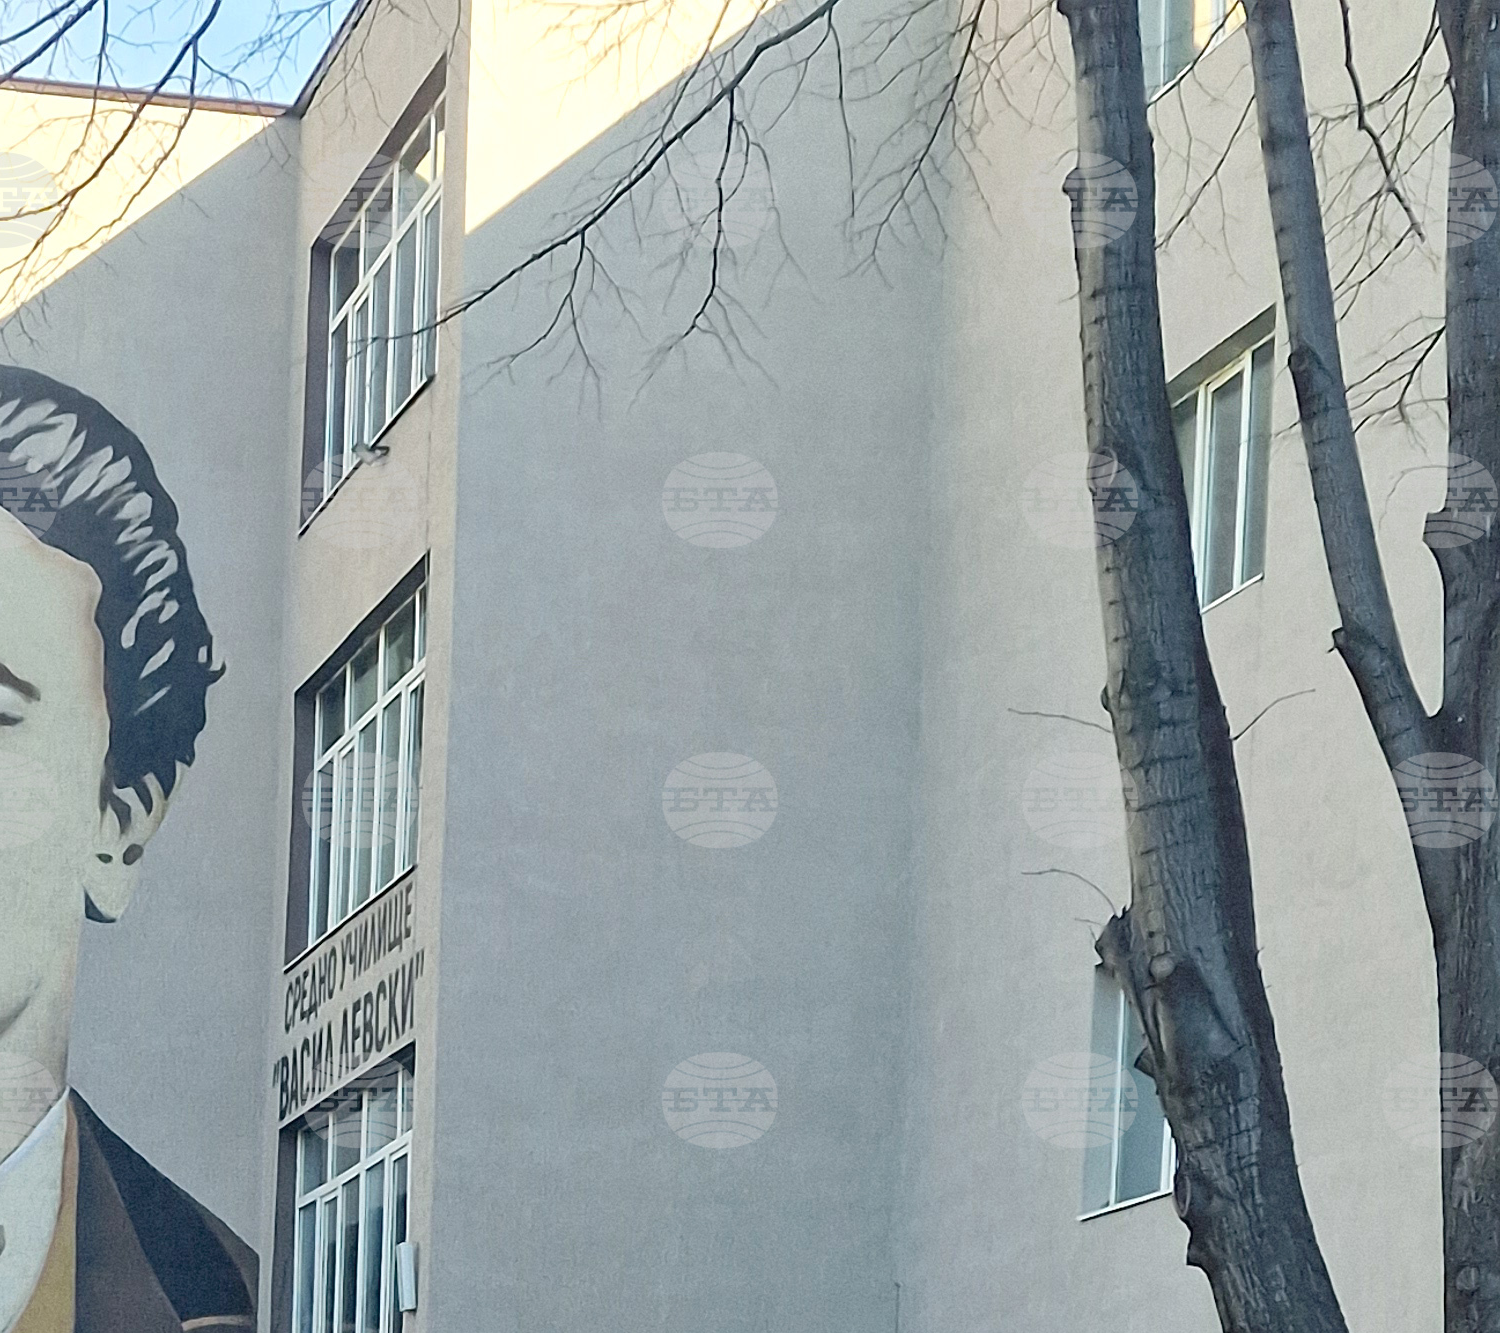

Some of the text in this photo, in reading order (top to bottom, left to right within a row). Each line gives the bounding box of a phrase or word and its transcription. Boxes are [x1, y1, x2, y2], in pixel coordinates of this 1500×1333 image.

[271, 947, 426, 1122] "ВАСИЛ ЛЕВСКИ"
[284, 881, 414, 1034] СРЕДНО УЧИЛИЩЕ
